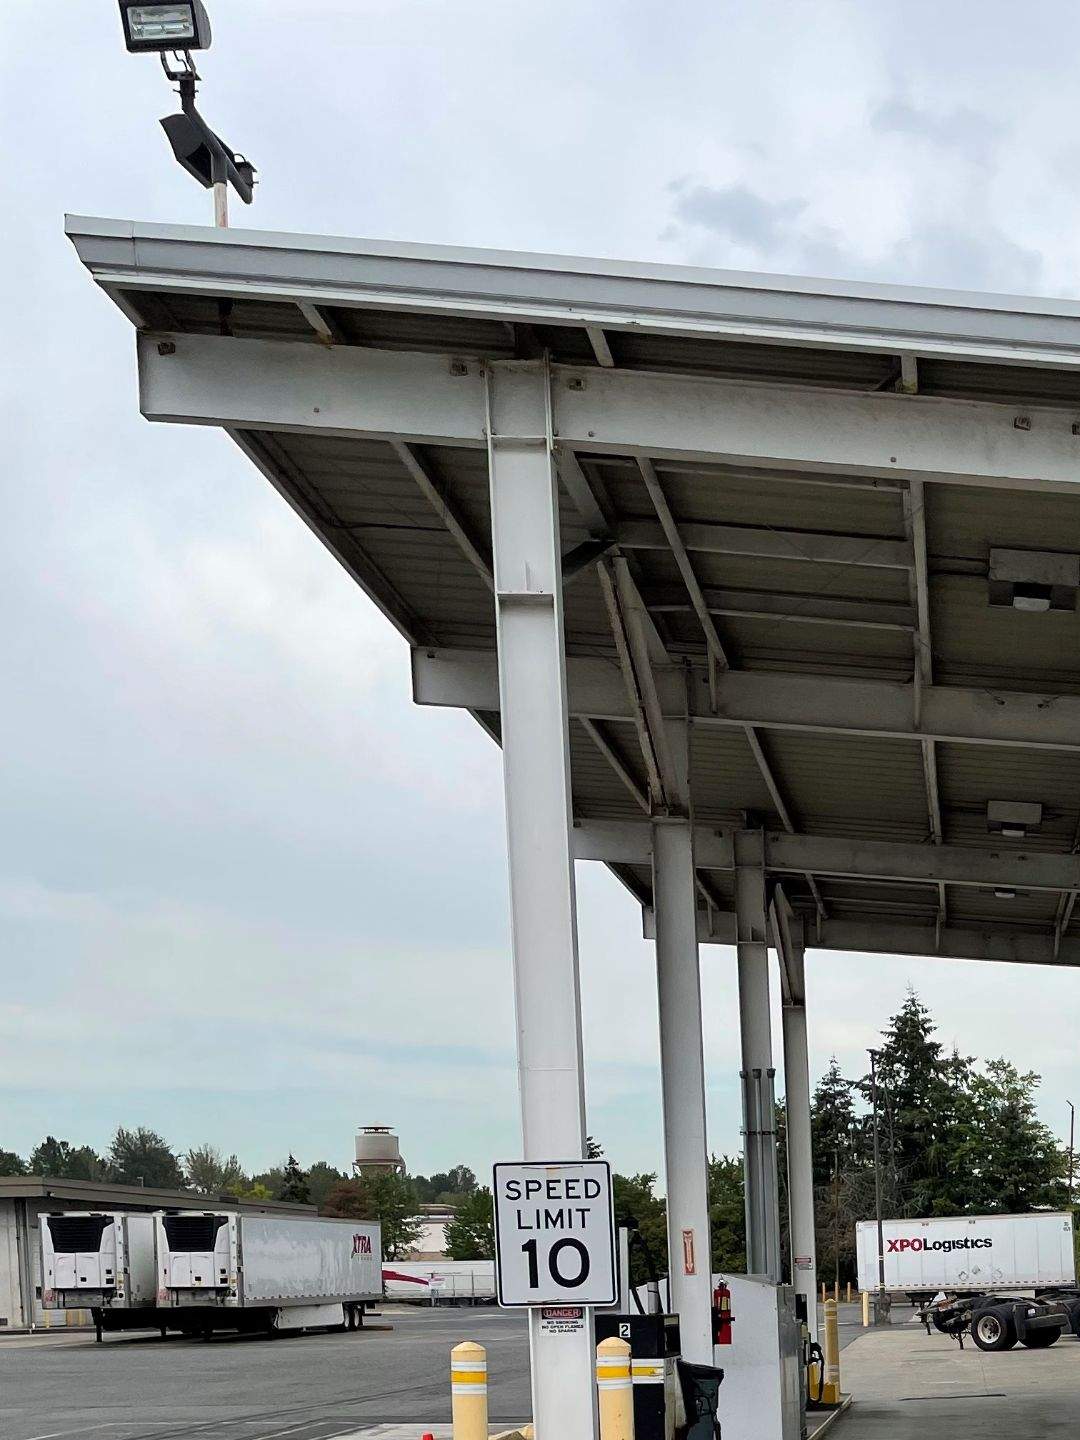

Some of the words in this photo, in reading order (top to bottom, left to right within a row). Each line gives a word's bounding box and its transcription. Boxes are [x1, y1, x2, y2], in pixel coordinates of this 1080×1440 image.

[505, 1179, 601, 1200] SPEED
[517, 1208, 590, 1229] LIMIT
[351, 1234, 372, 1256] XTRA
[521, 1238, 590, 1288] 10
[545, 1308, 579, 1317] DANGER
[621, 1324, 629, 1336] 2
